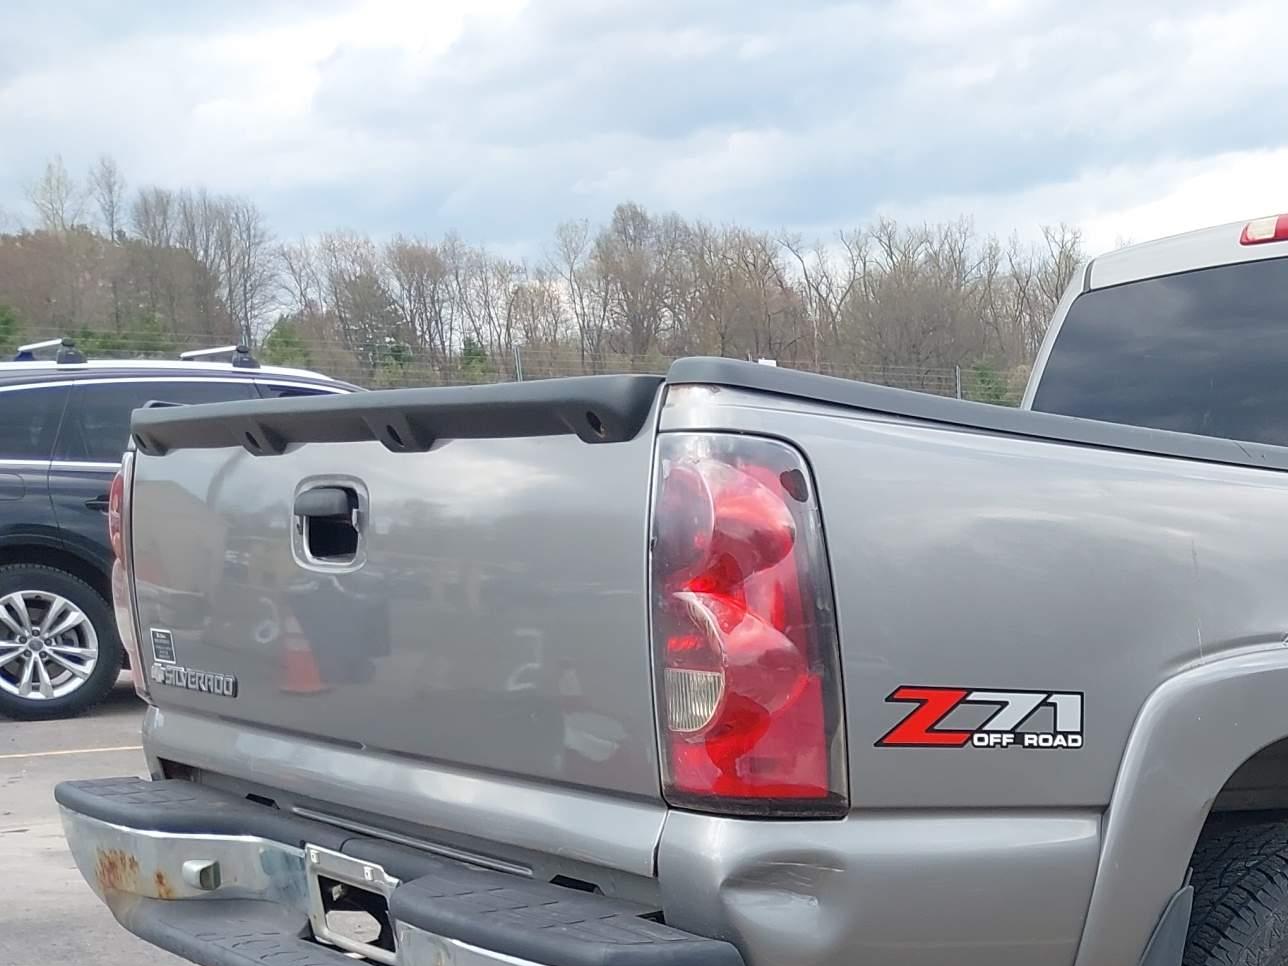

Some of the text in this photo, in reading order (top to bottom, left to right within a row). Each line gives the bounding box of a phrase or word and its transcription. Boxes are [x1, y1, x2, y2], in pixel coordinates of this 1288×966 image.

[164, 665, 235, 696] SILVERADO
[875, 685, 1084, 747] Z71
[973, 734, 1082, 747] OFF ROAD
